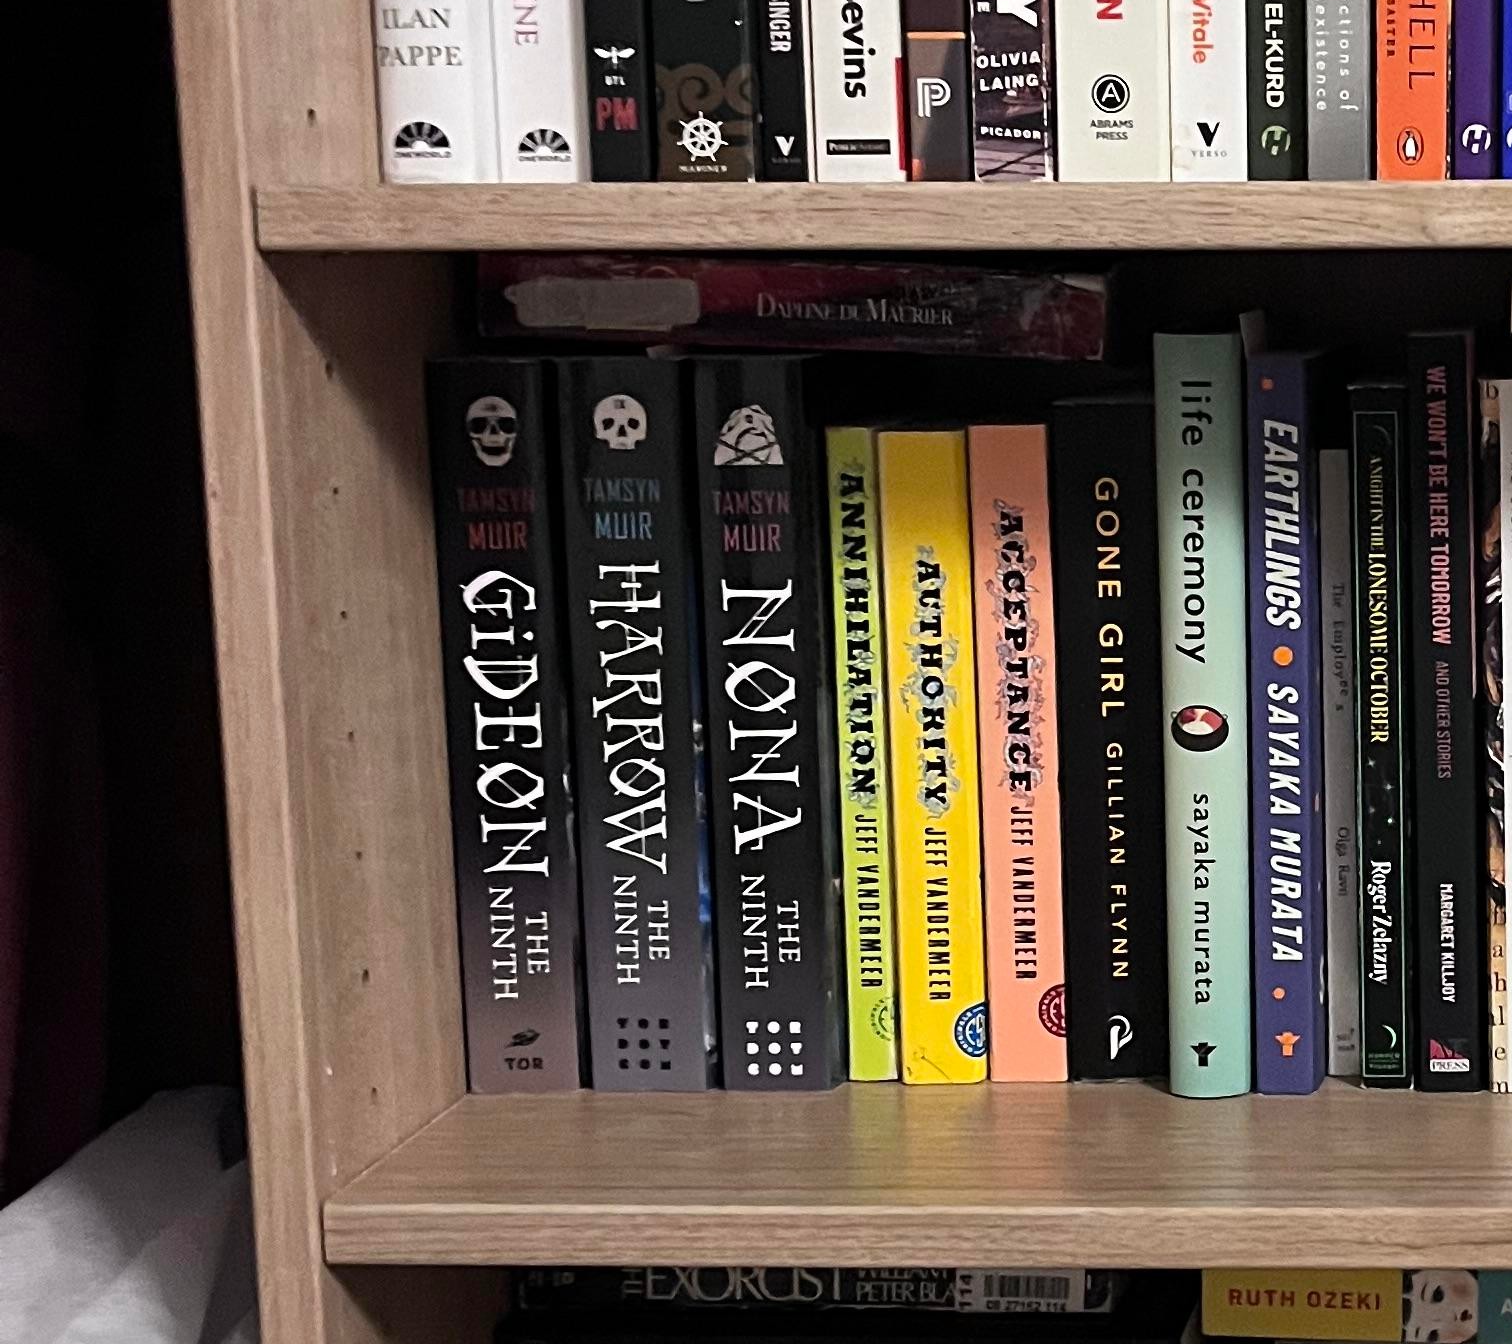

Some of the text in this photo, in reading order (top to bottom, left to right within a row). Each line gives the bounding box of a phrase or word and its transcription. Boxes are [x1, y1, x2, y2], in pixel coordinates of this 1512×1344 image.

[379, 46, 462, 68] PAPPE
[382, 9, 450, 30] ILAN
[977, 51, 1041, 92] OLIVIA LAING
[1265, 5, 1287, 108] EL-KURD
[1090, 119, 1134, 140] ABRAMS PRESS
[1175, 380, 1211, 664] life ceremony
[839, 473, 877, 795] ANNIHILATION
[916, 560, 947, 803] AUTHORITY
[1263, 419, 1304, 961] EARTHLINGS SAYAKA MURATA
[1095, 477, 1129, 978] GONE GIRL GILLIAN FLYNN
[925, 827, 951, 1002] JEFF VANDERMEER
[1187, 794, 1217, 1005] sayaka murata
[1229, 1288, 1380, 1310] RUTH OZEKI
